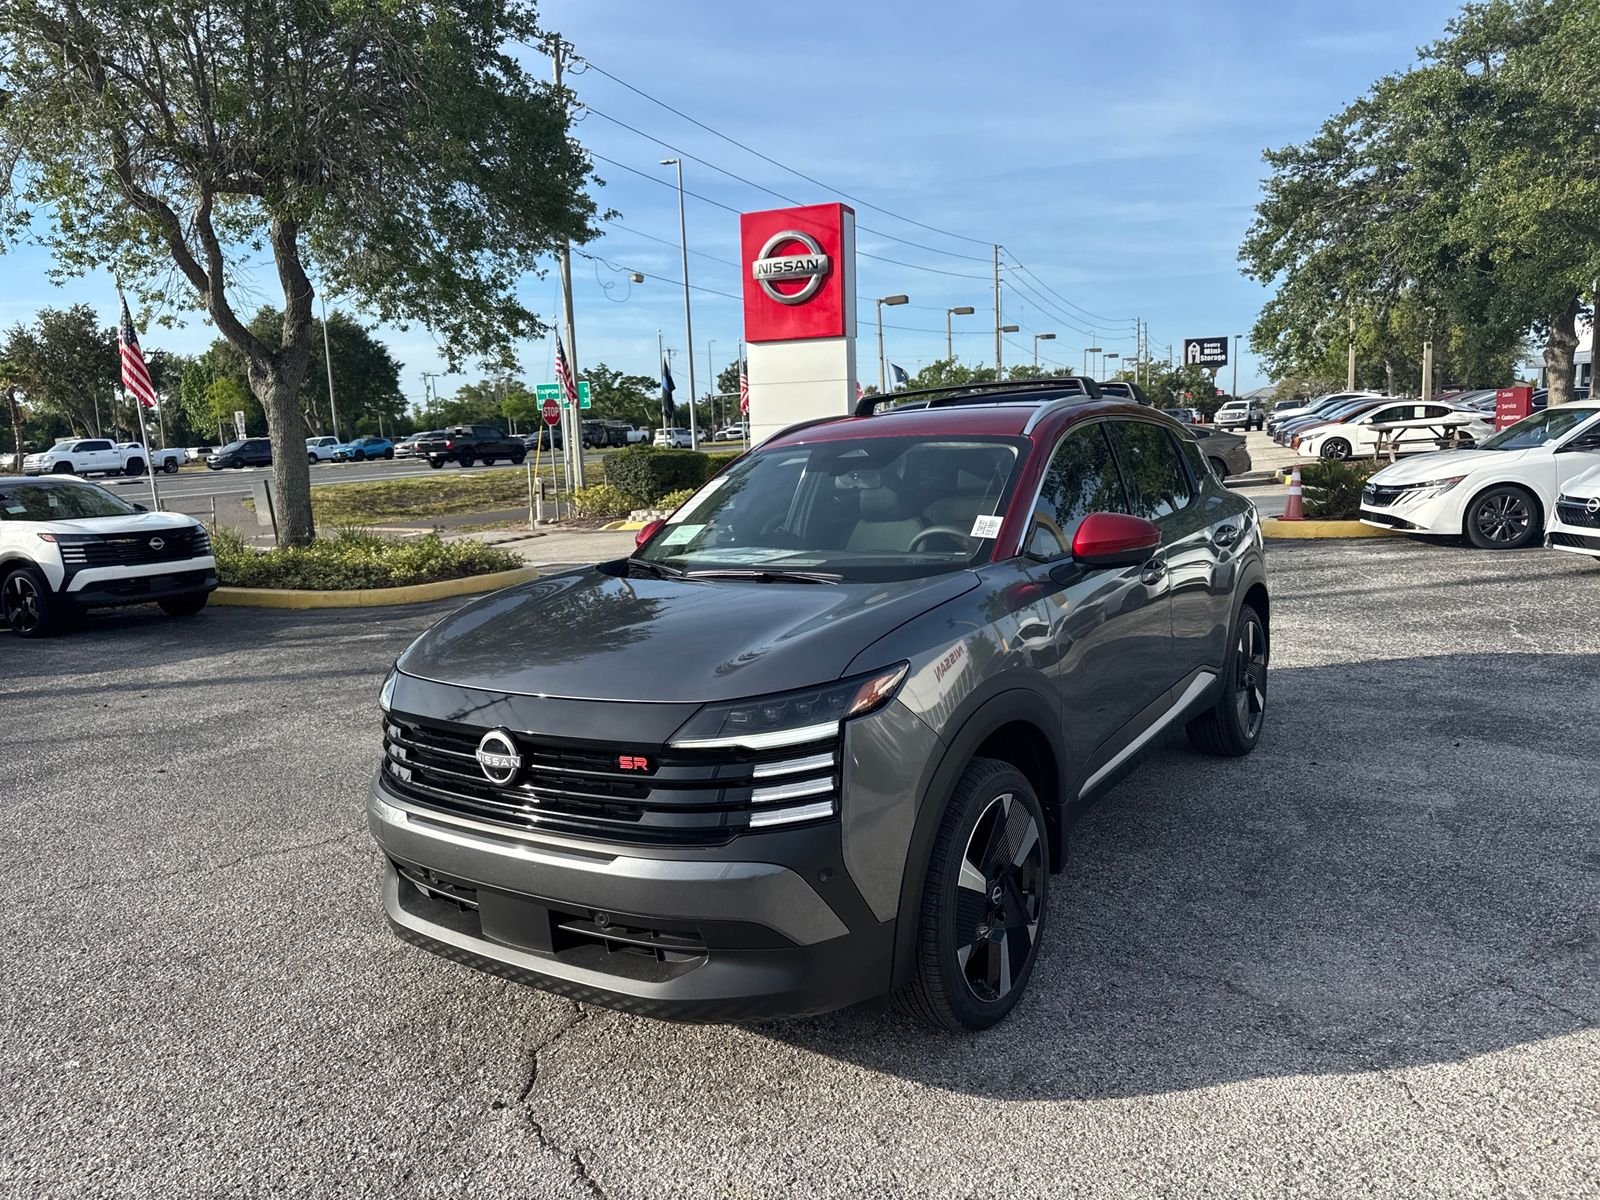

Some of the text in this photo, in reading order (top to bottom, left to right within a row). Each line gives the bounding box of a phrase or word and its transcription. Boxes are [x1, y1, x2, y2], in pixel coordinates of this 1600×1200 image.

[758, 258, 819, 274] NISSAN
[543, 407, 559, 417] STOP
[476, 751, 520, 768] NISSAN
[618, 755, 648, 771] SR
